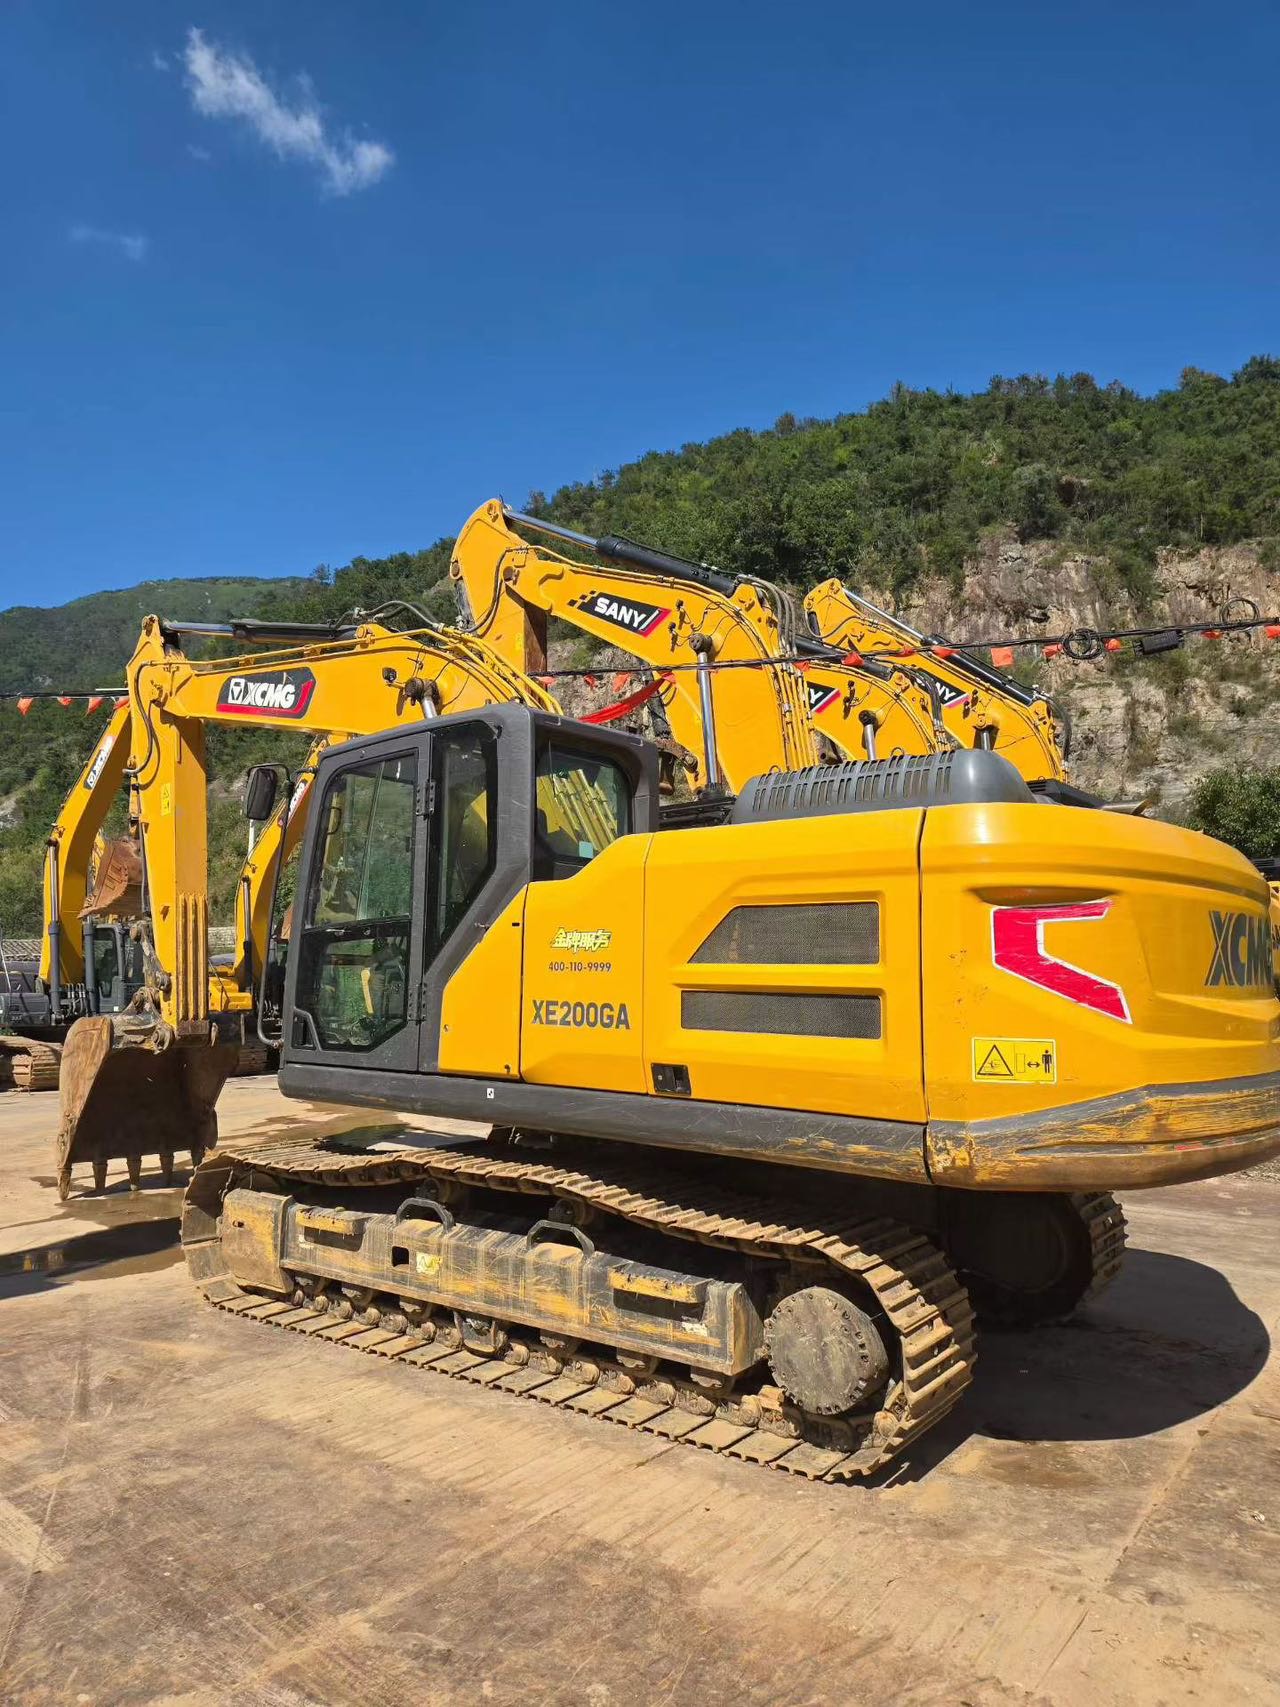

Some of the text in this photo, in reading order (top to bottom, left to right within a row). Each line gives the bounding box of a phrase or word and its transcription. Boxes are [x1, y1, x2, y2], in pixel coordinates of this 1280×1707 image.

[594, 597, 647, 628] SANY
[243, 682, 296, 709] XCMG
[551, 928, 611, 953] 金牌服务
[548, 961, 612, 973] 400-110-9999
[531, 999, 631, 1030] XE200GA
